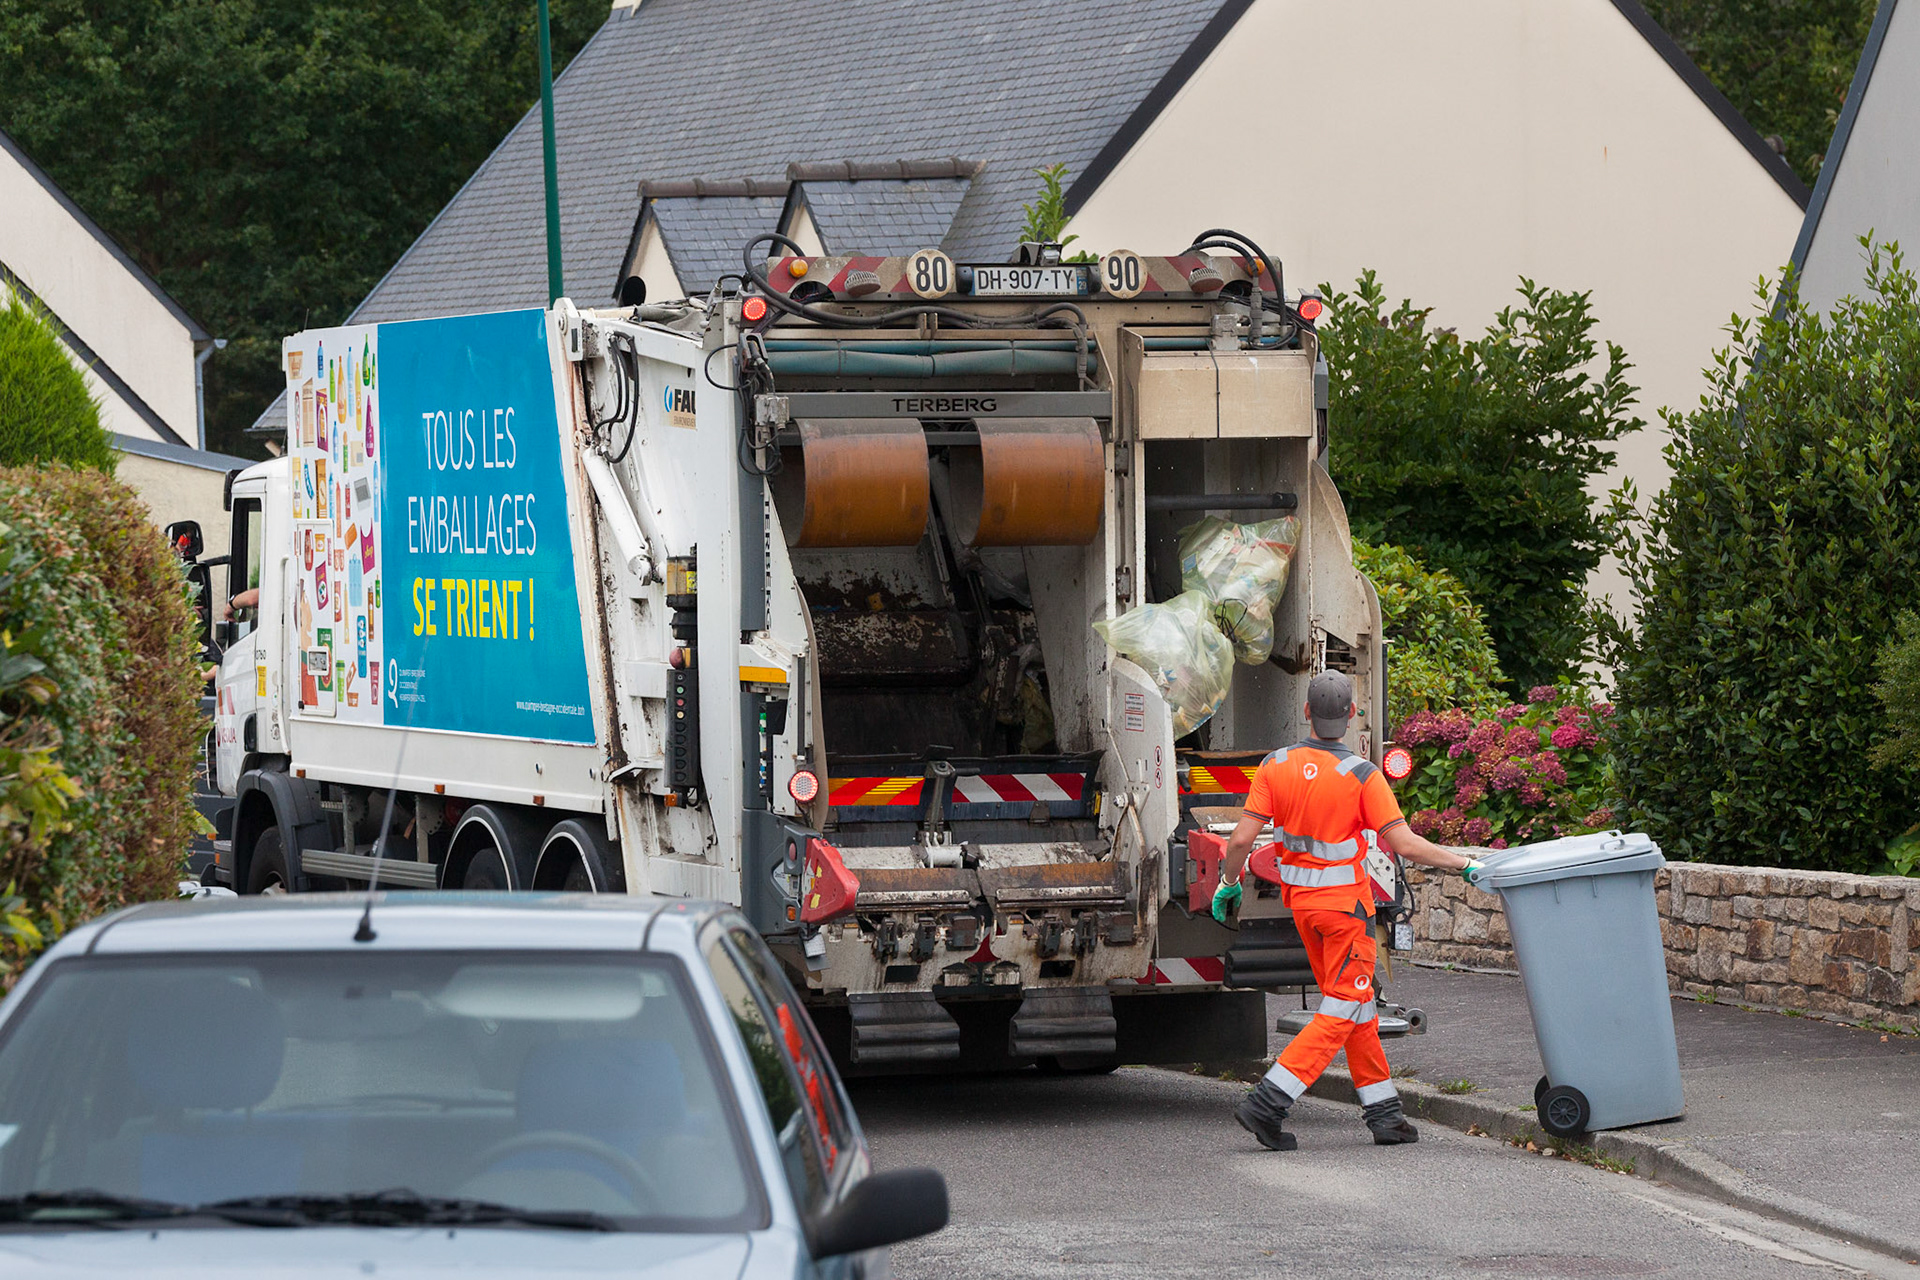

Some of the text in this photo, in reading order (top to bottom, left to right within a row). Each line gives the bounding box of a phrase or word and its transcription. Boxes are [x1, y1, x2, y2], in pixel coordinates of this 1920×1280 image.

[915, 255, 949, 293] 80
[977, 269, 1074, 290] DH-907-TY
[1078, 281, 1088, 290] 29
[1108, 255, 1141, 292] 90
[891, 397, 998, 413] TERBERG
[422, 406, 517, 471] TOUS LES
[408, 493, 537, 556] EMBALLAGES
[413, 577, 437, 637] SE
[442, 578, 523, 640] TRIENT
